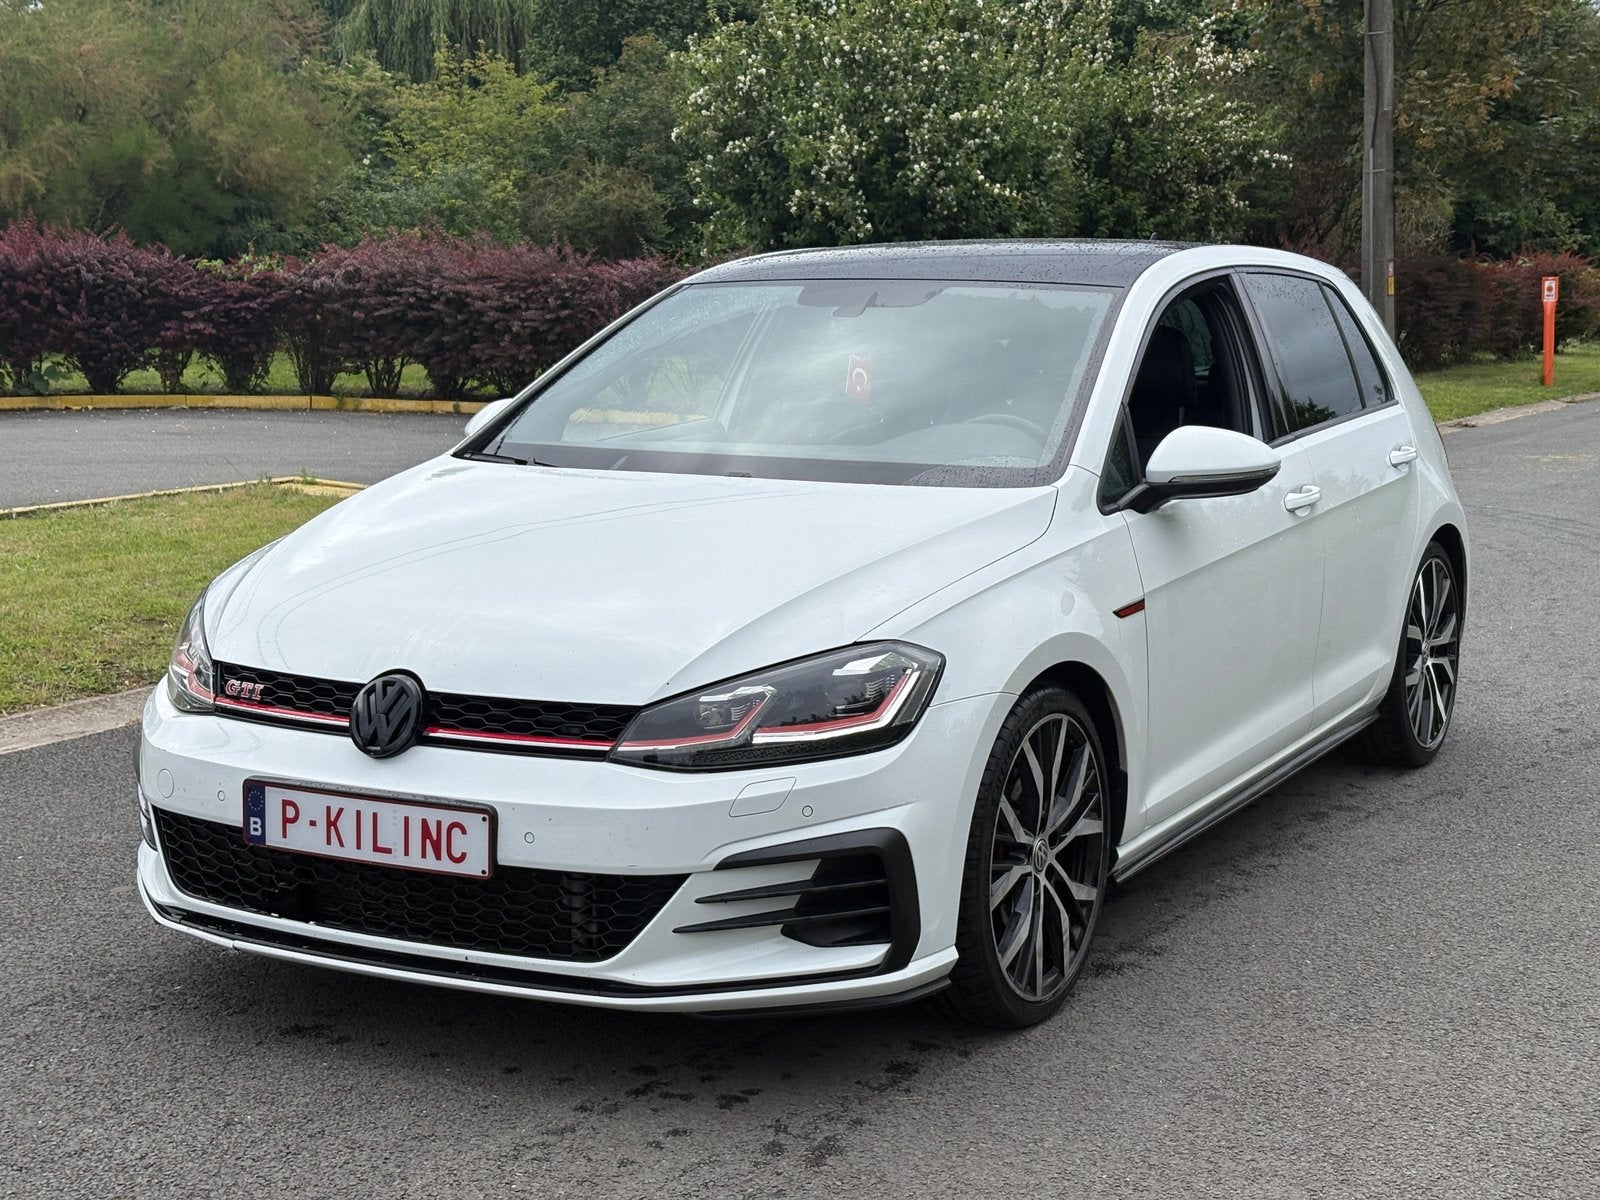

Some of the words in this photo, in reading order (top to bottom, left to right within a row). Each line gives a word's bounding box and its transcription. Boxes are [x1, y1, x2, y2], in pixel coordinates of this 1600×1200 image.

[225, 679, 264, 700] GTI
[354, 675, 420, 755] VW
[249, 816, 262, 836] B
[281, 799, 468, 864] P-KILINC
